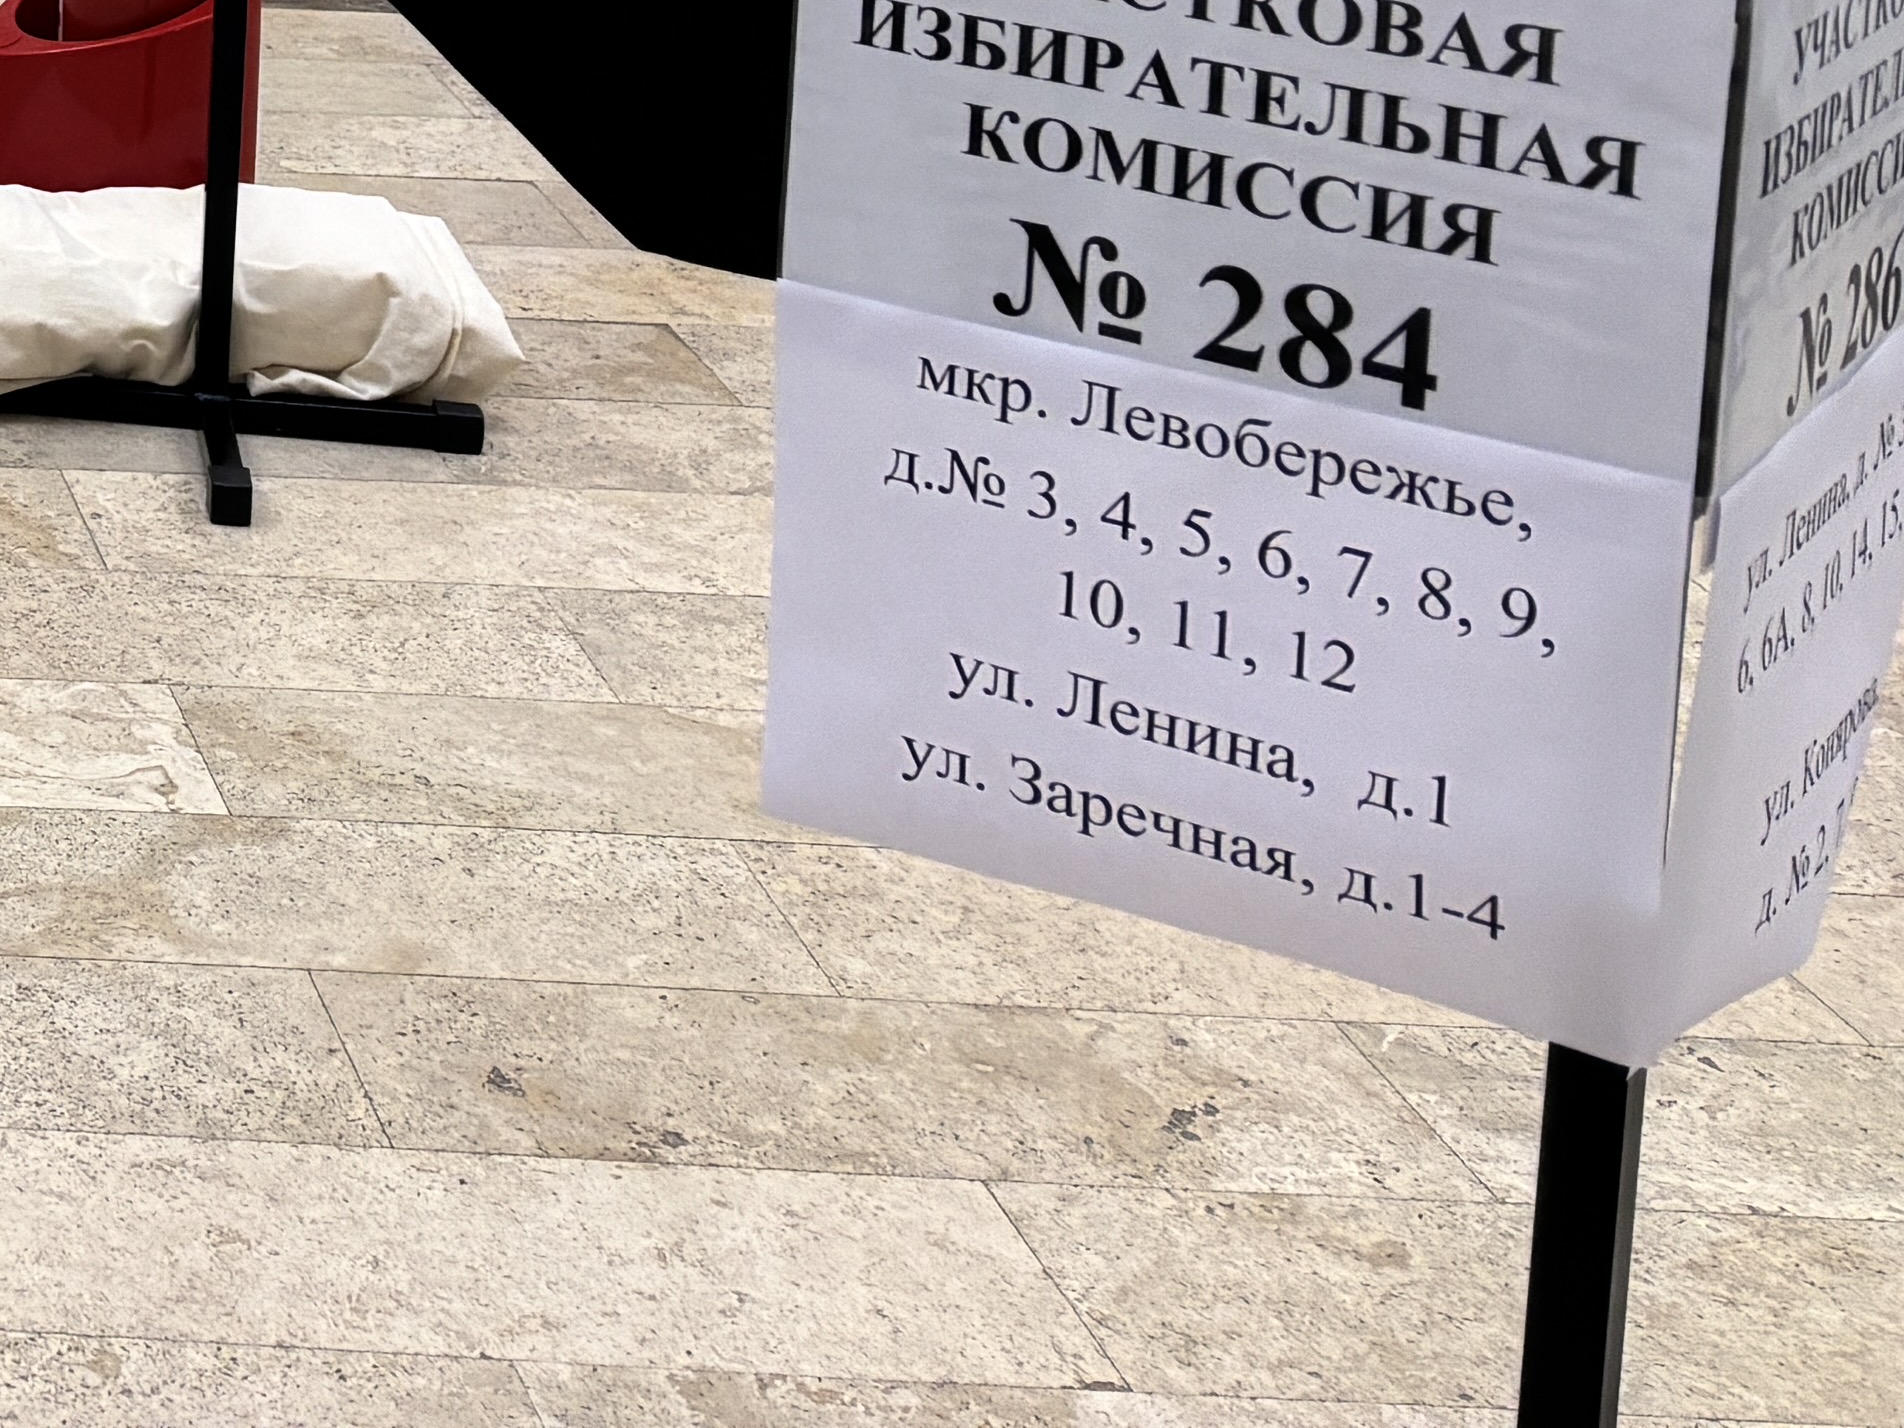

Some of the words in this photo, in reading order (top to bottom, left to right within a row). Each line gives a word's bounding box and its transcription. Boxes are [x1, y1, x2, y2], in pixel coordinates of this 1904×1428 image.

[960, 102, 1503, 266] КОМИССИЯ
[1759, 46, 1904, 200] ИЗБИРАТЕЛ
[992, 218, 1147, 345] №
[1193, 264, 1439, 411] 284
[1786, 290, 1833, 417] №
[1839, 226, 1904, 371] 286
[915, 356, 1048, 424] мкр.
[1071, 379, 1534, 543] Левобережье,
[1742, 546, 1774, 614] ул.
[1873, 413, 1896, 471] №
[883, 448, 1006, 509] д.№
[1027, 470, 1078, 537] 3,
[1100, 490, 1154, 556] 4,
[1179, 508, 1232, 574] 5,
[1257, 529, 1311, 595] 6,
[1337, 546, 1390, 616] 7,
[1418, 566, 1472, 637] 8,
[1499, 586, 1556, 658] 9,
[1058, 570, 1142, 646] 10,
[1173, 600, 1258, 676] 11,
[1290, 630, 1357, 693] 12
[948, 651, 1036, 708] ул.
[1056, 670, 1316, 797] Ленина,
[1357, 769, 1452, 828] д.1
[1759, 779, 1795, 846] ул.
[901, 734, 987, 792] ул.
[1009, 753, 1316, 896] Заречная,
[1337, 866, 1506, 941] д.1-4
[1784, 844, 1810, 906] №
